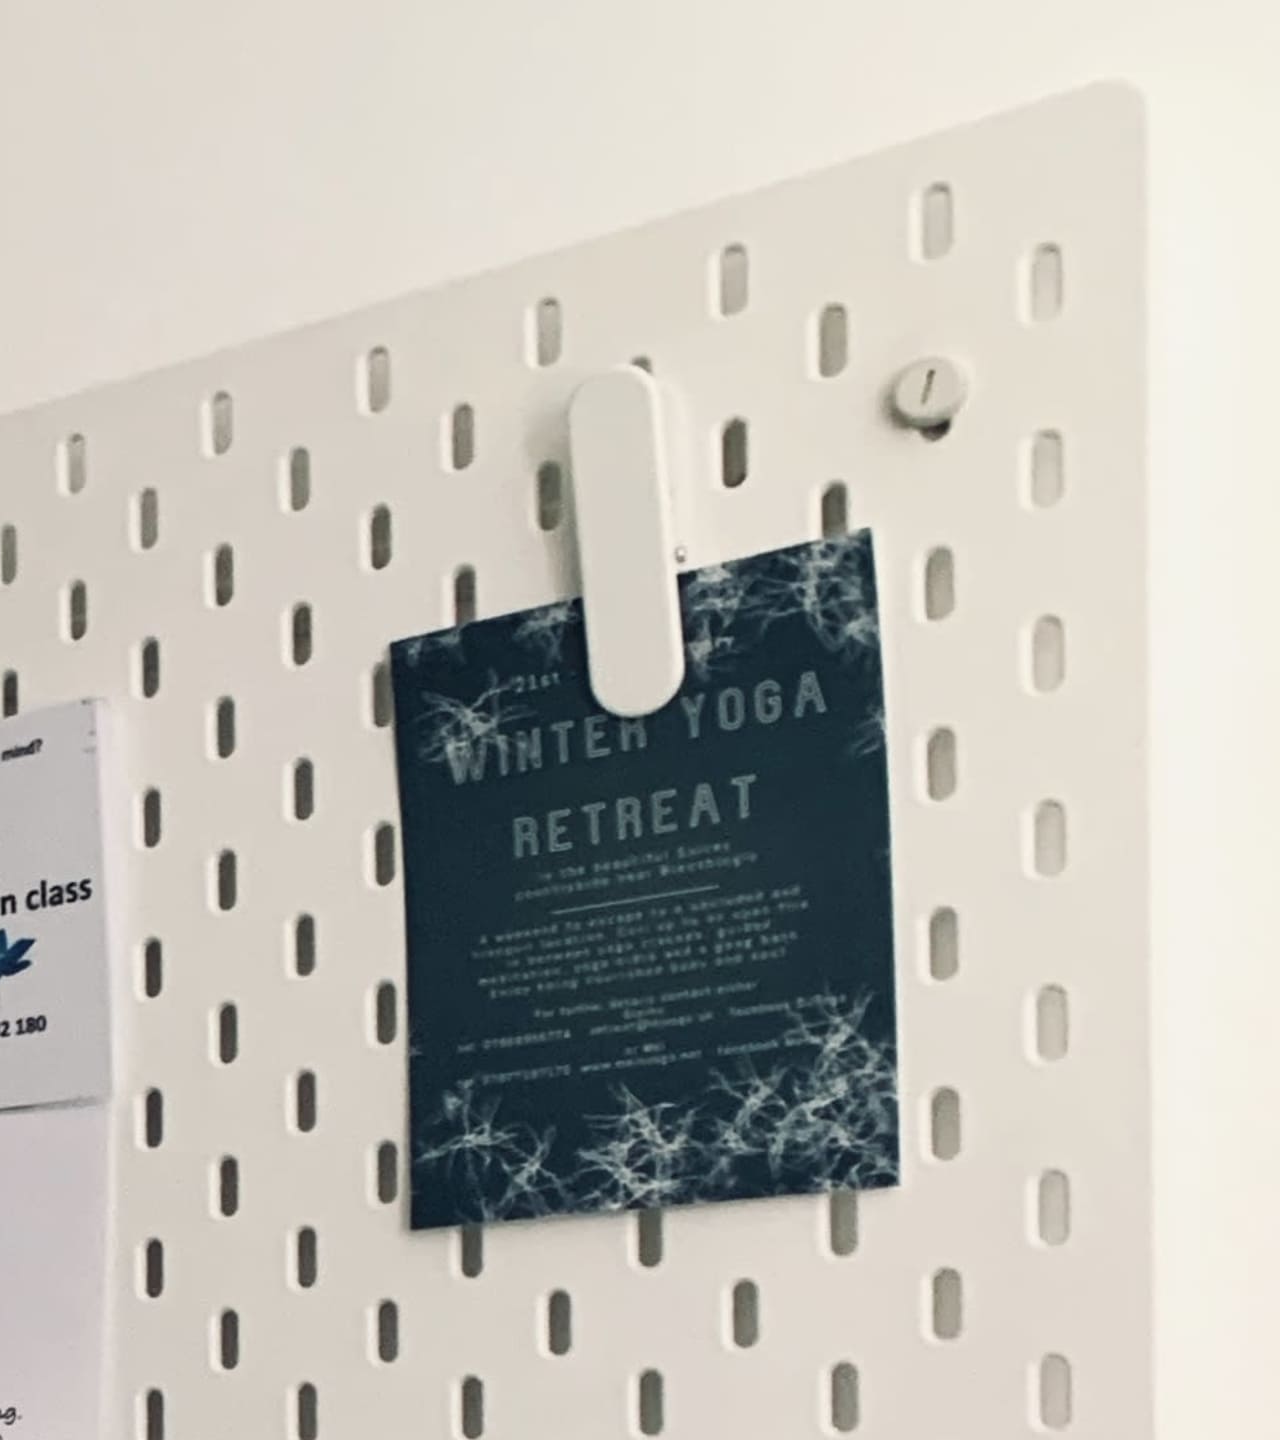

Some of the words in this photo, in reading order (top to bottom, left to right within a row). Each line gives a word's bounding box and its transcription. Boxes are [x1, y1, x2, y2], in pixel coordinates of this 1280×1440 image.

[445, 714, 647, 785] WINTER
[680, 671, 827, 738] YOGA
[2, 738, 43, 761] mind?
[513, 774, 757, 858] RETREAT
[26, 878, 92, 911] class
[15, 1015, 47, 1036] 180
